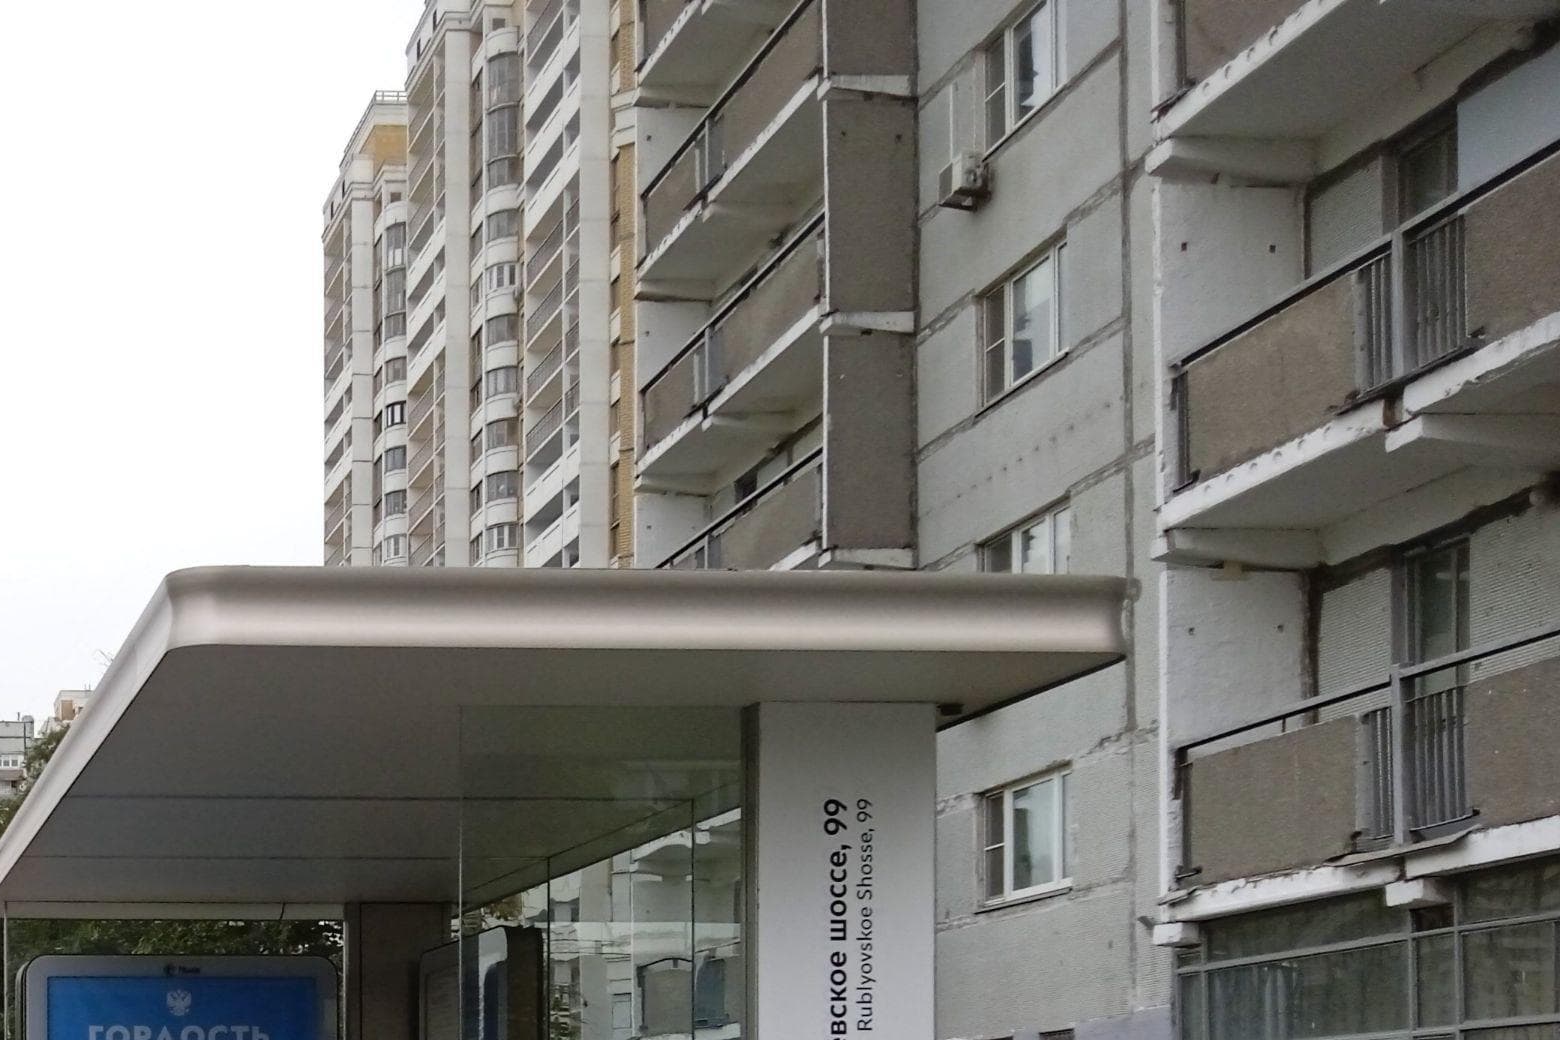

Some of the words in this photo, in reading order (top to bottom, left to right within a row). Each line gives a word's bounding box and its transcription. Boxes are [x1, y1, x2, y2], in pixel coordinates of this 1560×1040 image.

[824, 798, 848, 836] 99
[856, 798, 873, 823] 99
[829, 844, 852, 941] шоссе,
[856, 828, 875, 903] Shosse,
[856, 906, 876, 1032] Rublyovskoe
